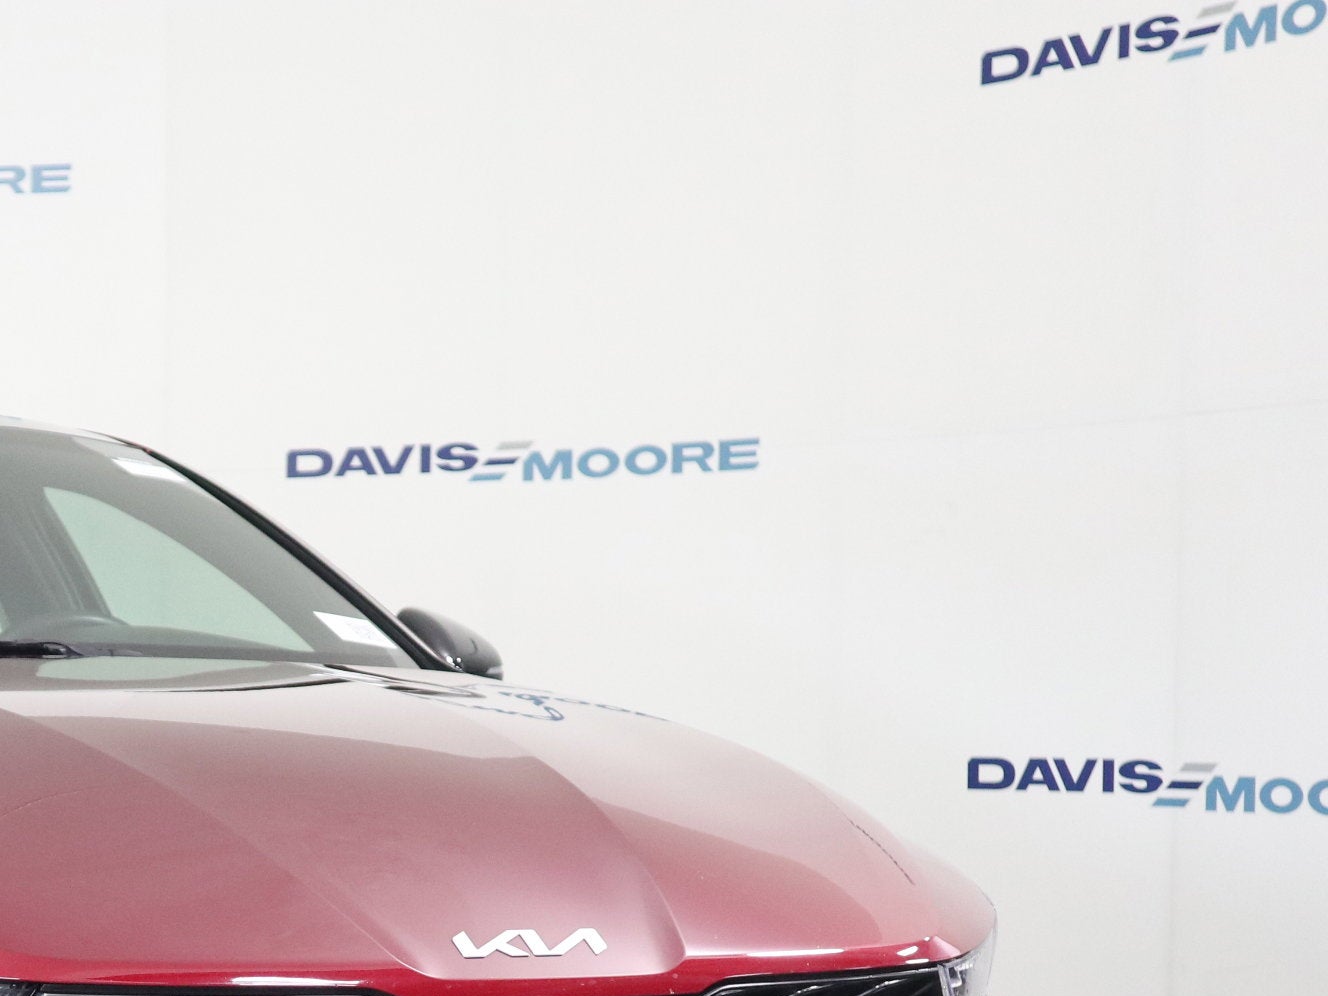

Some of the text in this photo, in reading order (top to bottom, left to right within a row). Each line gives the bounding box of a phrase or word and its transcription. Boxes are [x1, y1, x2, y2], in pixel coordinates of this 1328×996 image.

[980, 14, 1180, 87] DAVIS
[286, 438, 761, 483] DAVIS MOORE
[966, 756, 1164, 795] DAVIS
[451, 927, 608, 959] KIA
